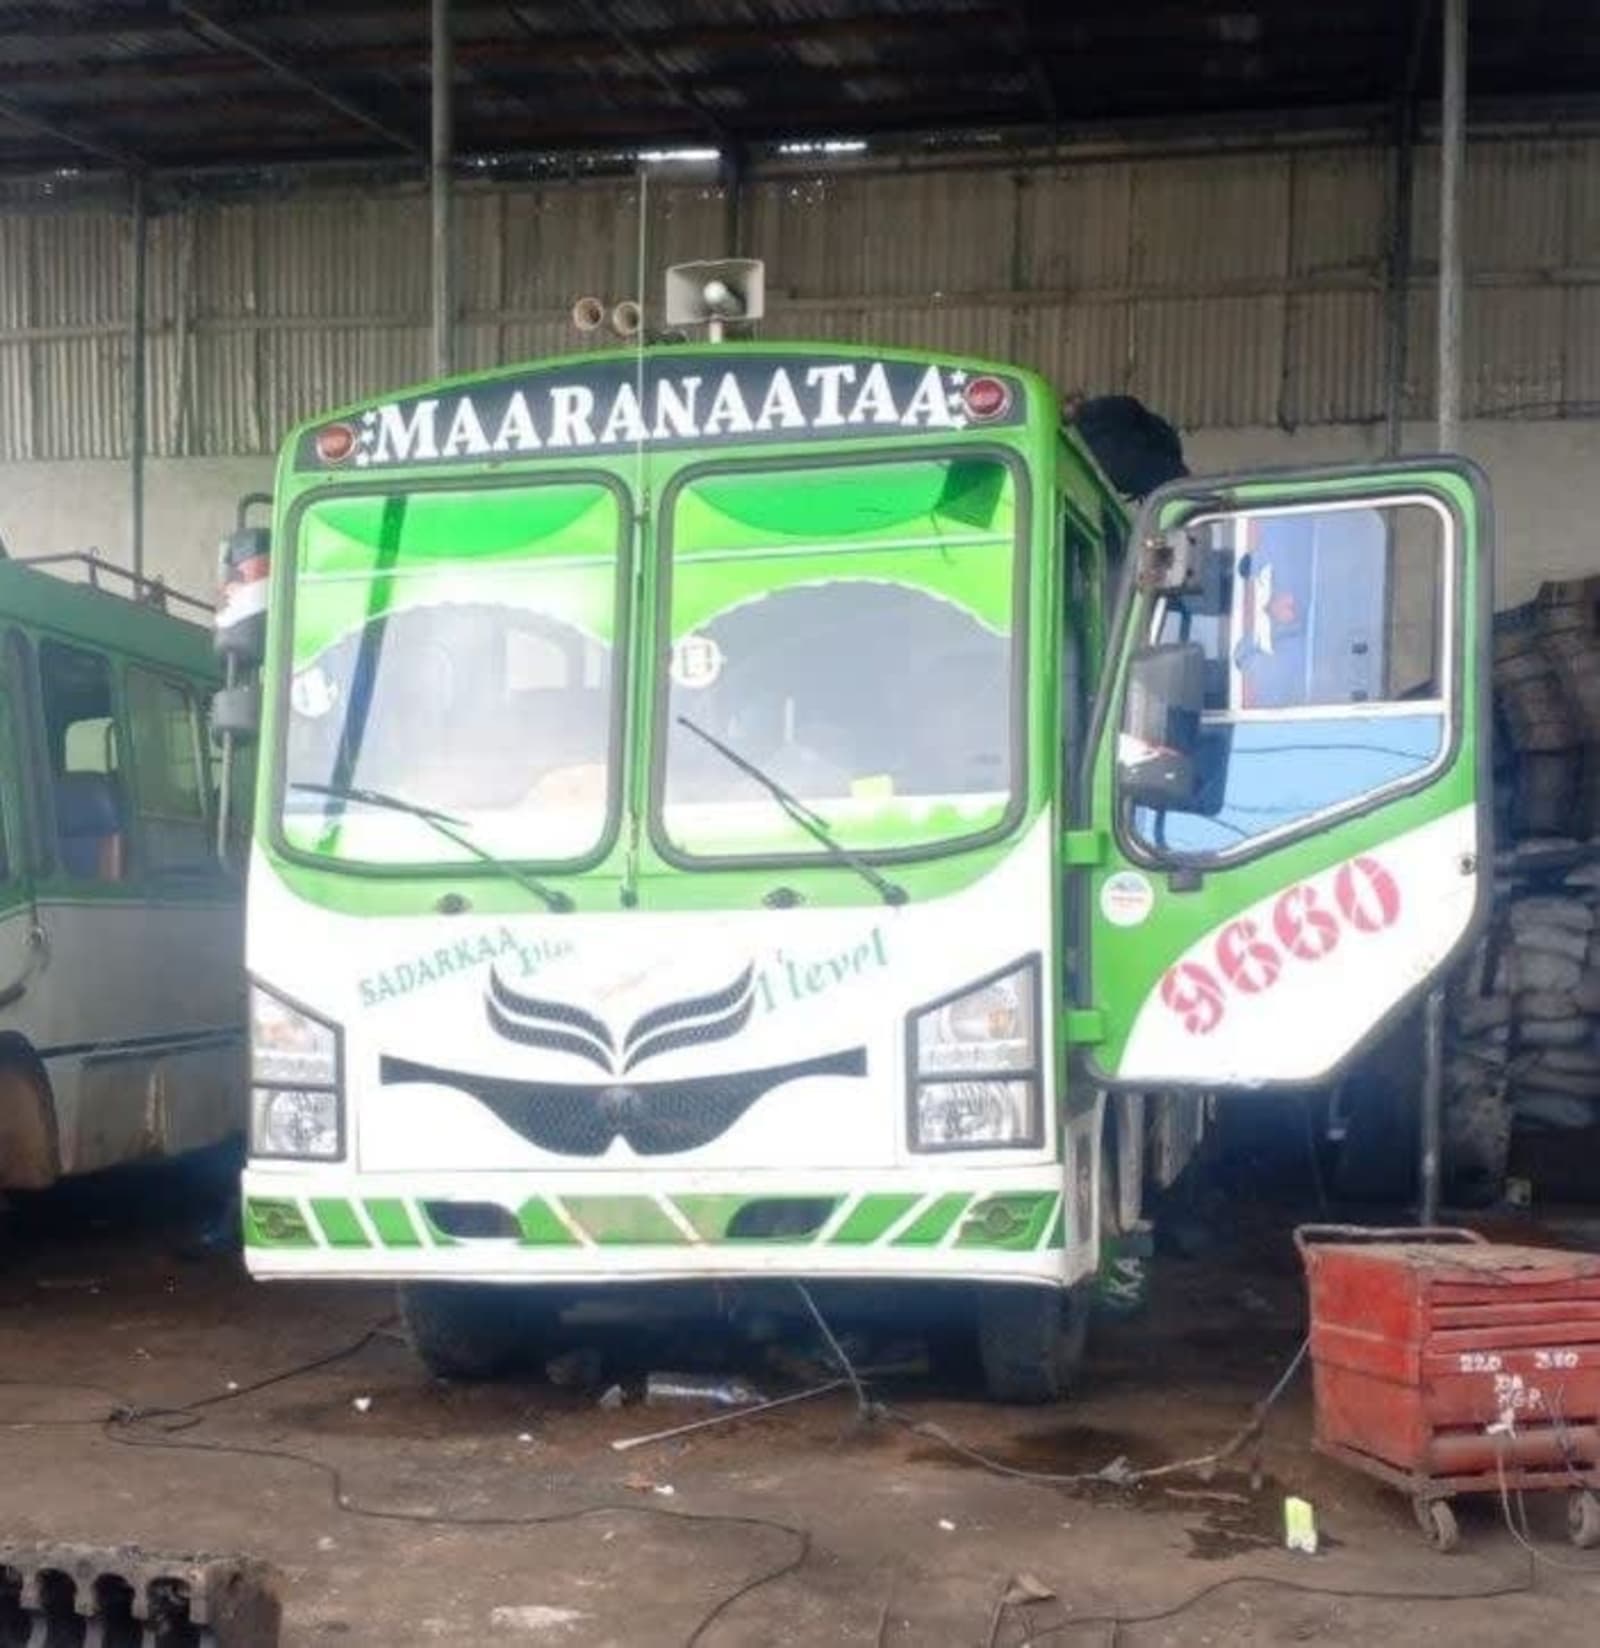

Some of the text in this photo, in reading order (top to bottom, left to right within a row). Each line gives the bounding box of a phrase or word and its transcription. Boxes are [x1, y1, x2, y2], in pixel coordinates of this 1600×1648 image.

[372, 364, 946, 463] MAARANAATAA
[358, 925, 518, 1007] SADARKAA
[1160, 856, 1401, 1036] 9660
